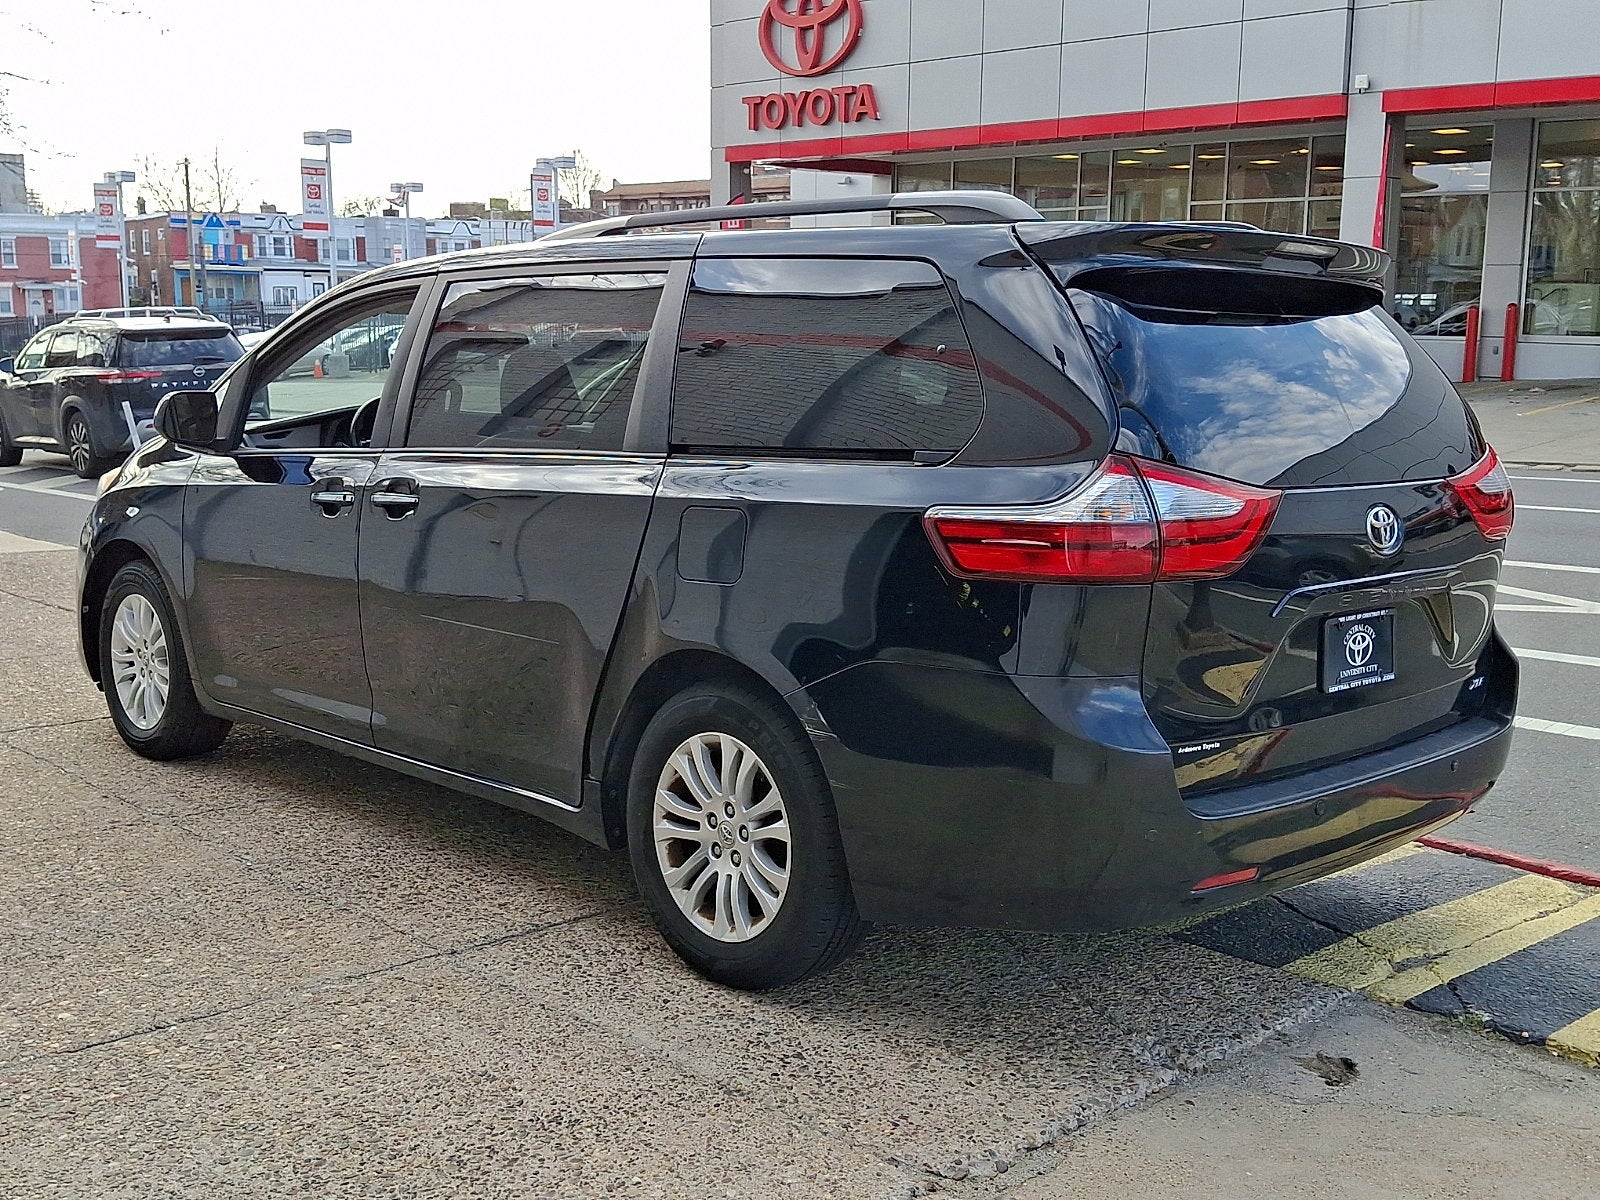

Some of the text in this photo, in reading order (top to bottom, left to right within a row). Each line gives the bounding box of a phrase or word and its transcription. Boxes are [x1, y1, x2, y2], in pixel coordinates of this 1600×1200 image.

[742, 84, 880, 131] TOYOTA
[1344, 624, 1377, 644] CENTRAL CITY
[1340, 664, 1378, 678] UNIVERSITY CITY
[1328, 683, 1350, 692] CENTRAL
[1362, 677, 1381, 685] TOYOTA
